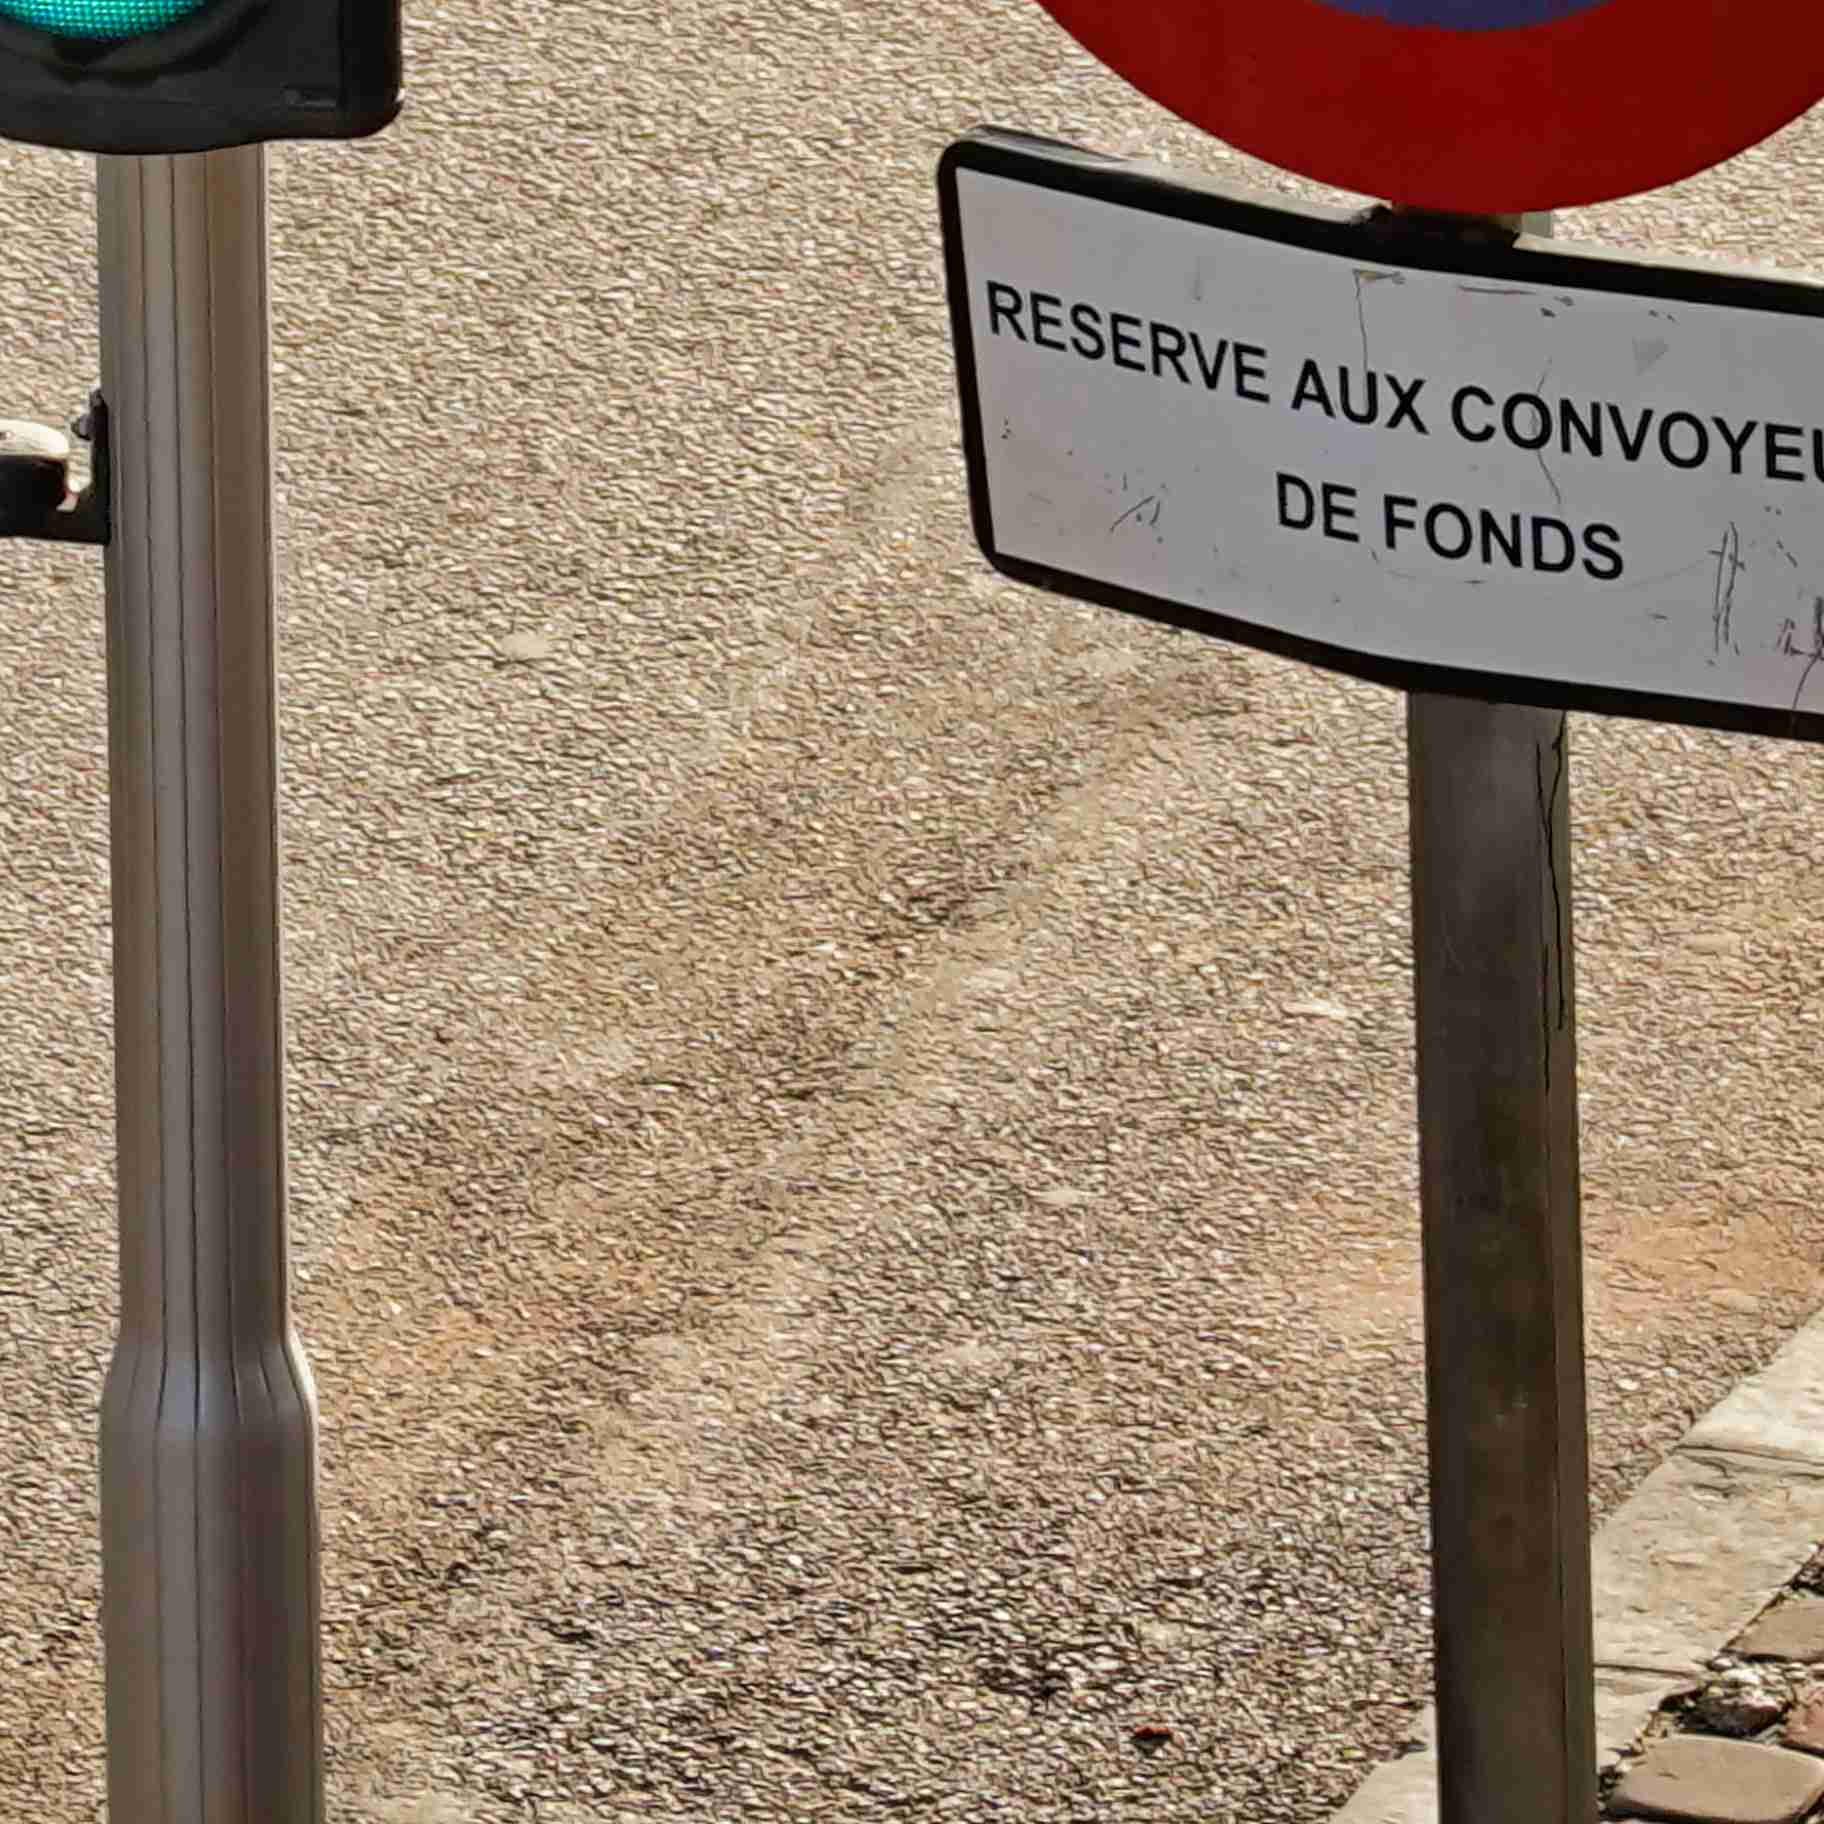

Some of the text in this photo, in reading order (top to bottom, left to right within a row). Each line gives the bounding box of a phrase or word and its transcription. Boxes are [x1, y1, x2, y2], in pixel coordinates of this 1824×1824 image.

[985, 279, 1271, 404] RESERVE
[1290, 358, 1430, 436] AUX
[1275, 471, 1625, 582] DE FONDS
